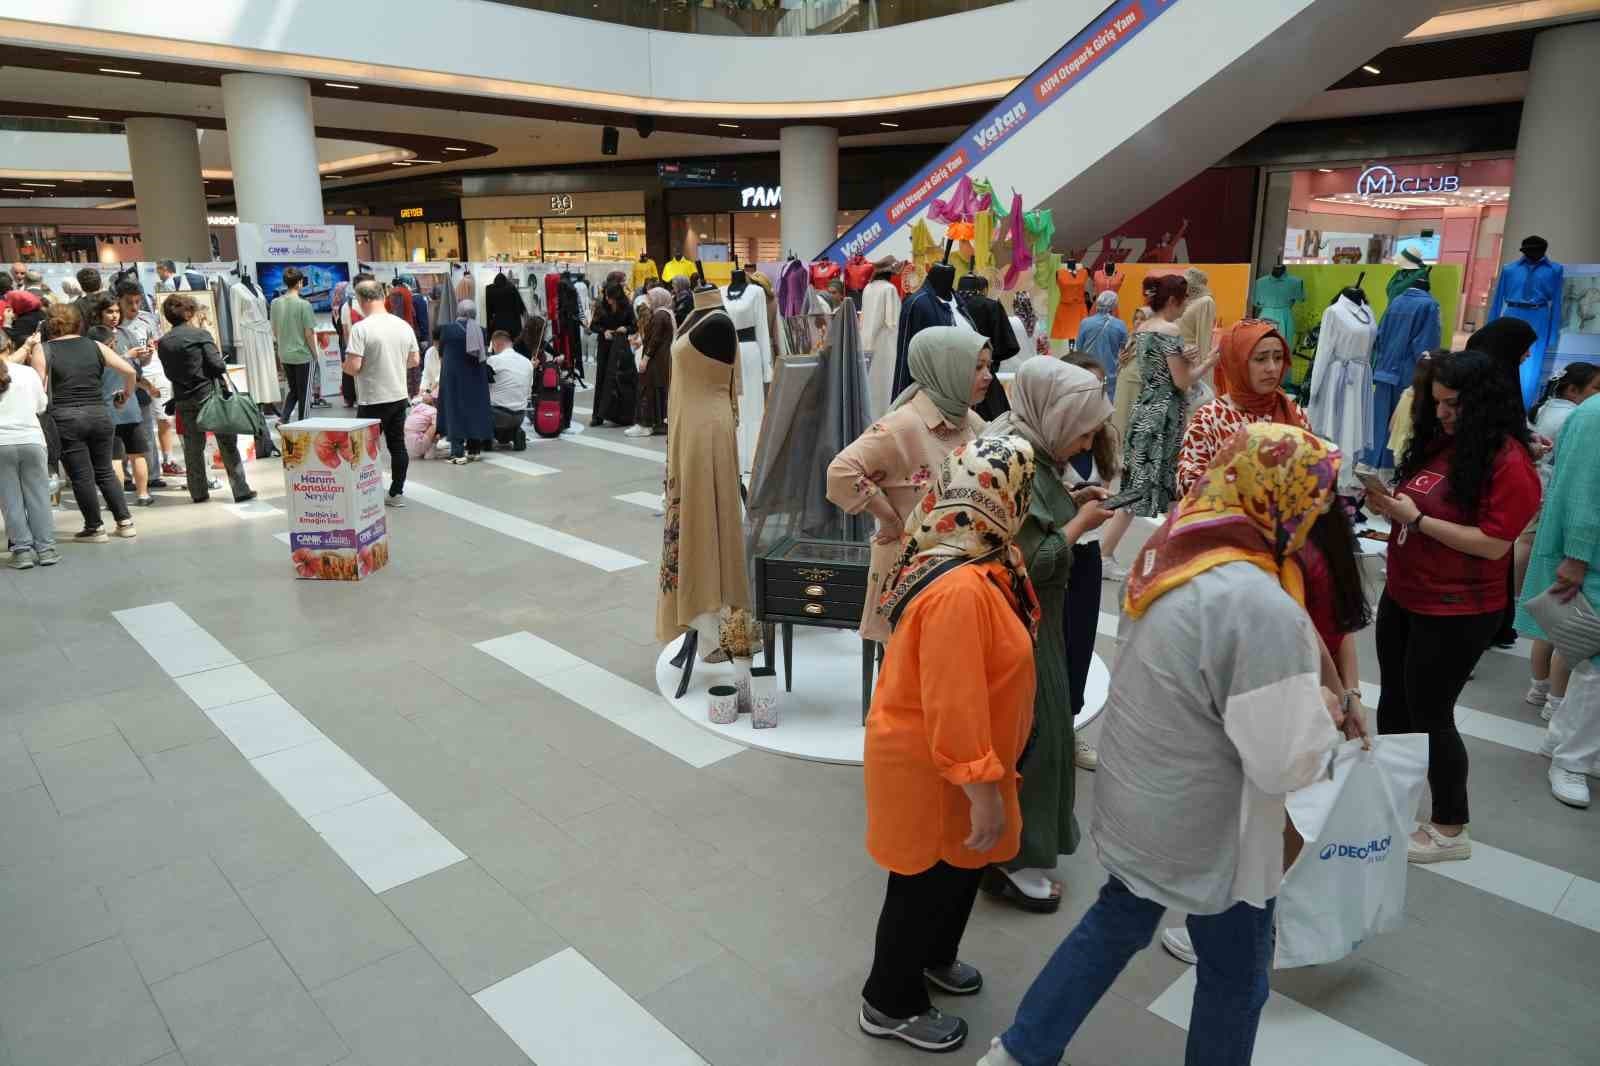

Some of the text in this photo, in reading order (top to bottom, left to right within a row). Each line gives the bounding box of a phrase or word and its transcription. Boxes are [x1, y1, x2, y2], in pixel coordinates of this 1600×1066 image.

[1040, 73, 1061, 96] AVM
[1058, 45, 1095, 79] Otopark
[1092, 29, 1117, 51] Giriş
[973, 102, 1026, 146] Vatan
[741, 186, 782, 208] PAN
[891, 199, 907, 219] AVM
[904, 180, 932, 207] Otopark
[930, 167, 950, 186] Giriş
[1400, 176, 1459, 192] CLUB
[840, 222, 881, 257] Vatan
[301, 474, 336, 484] Hanım
